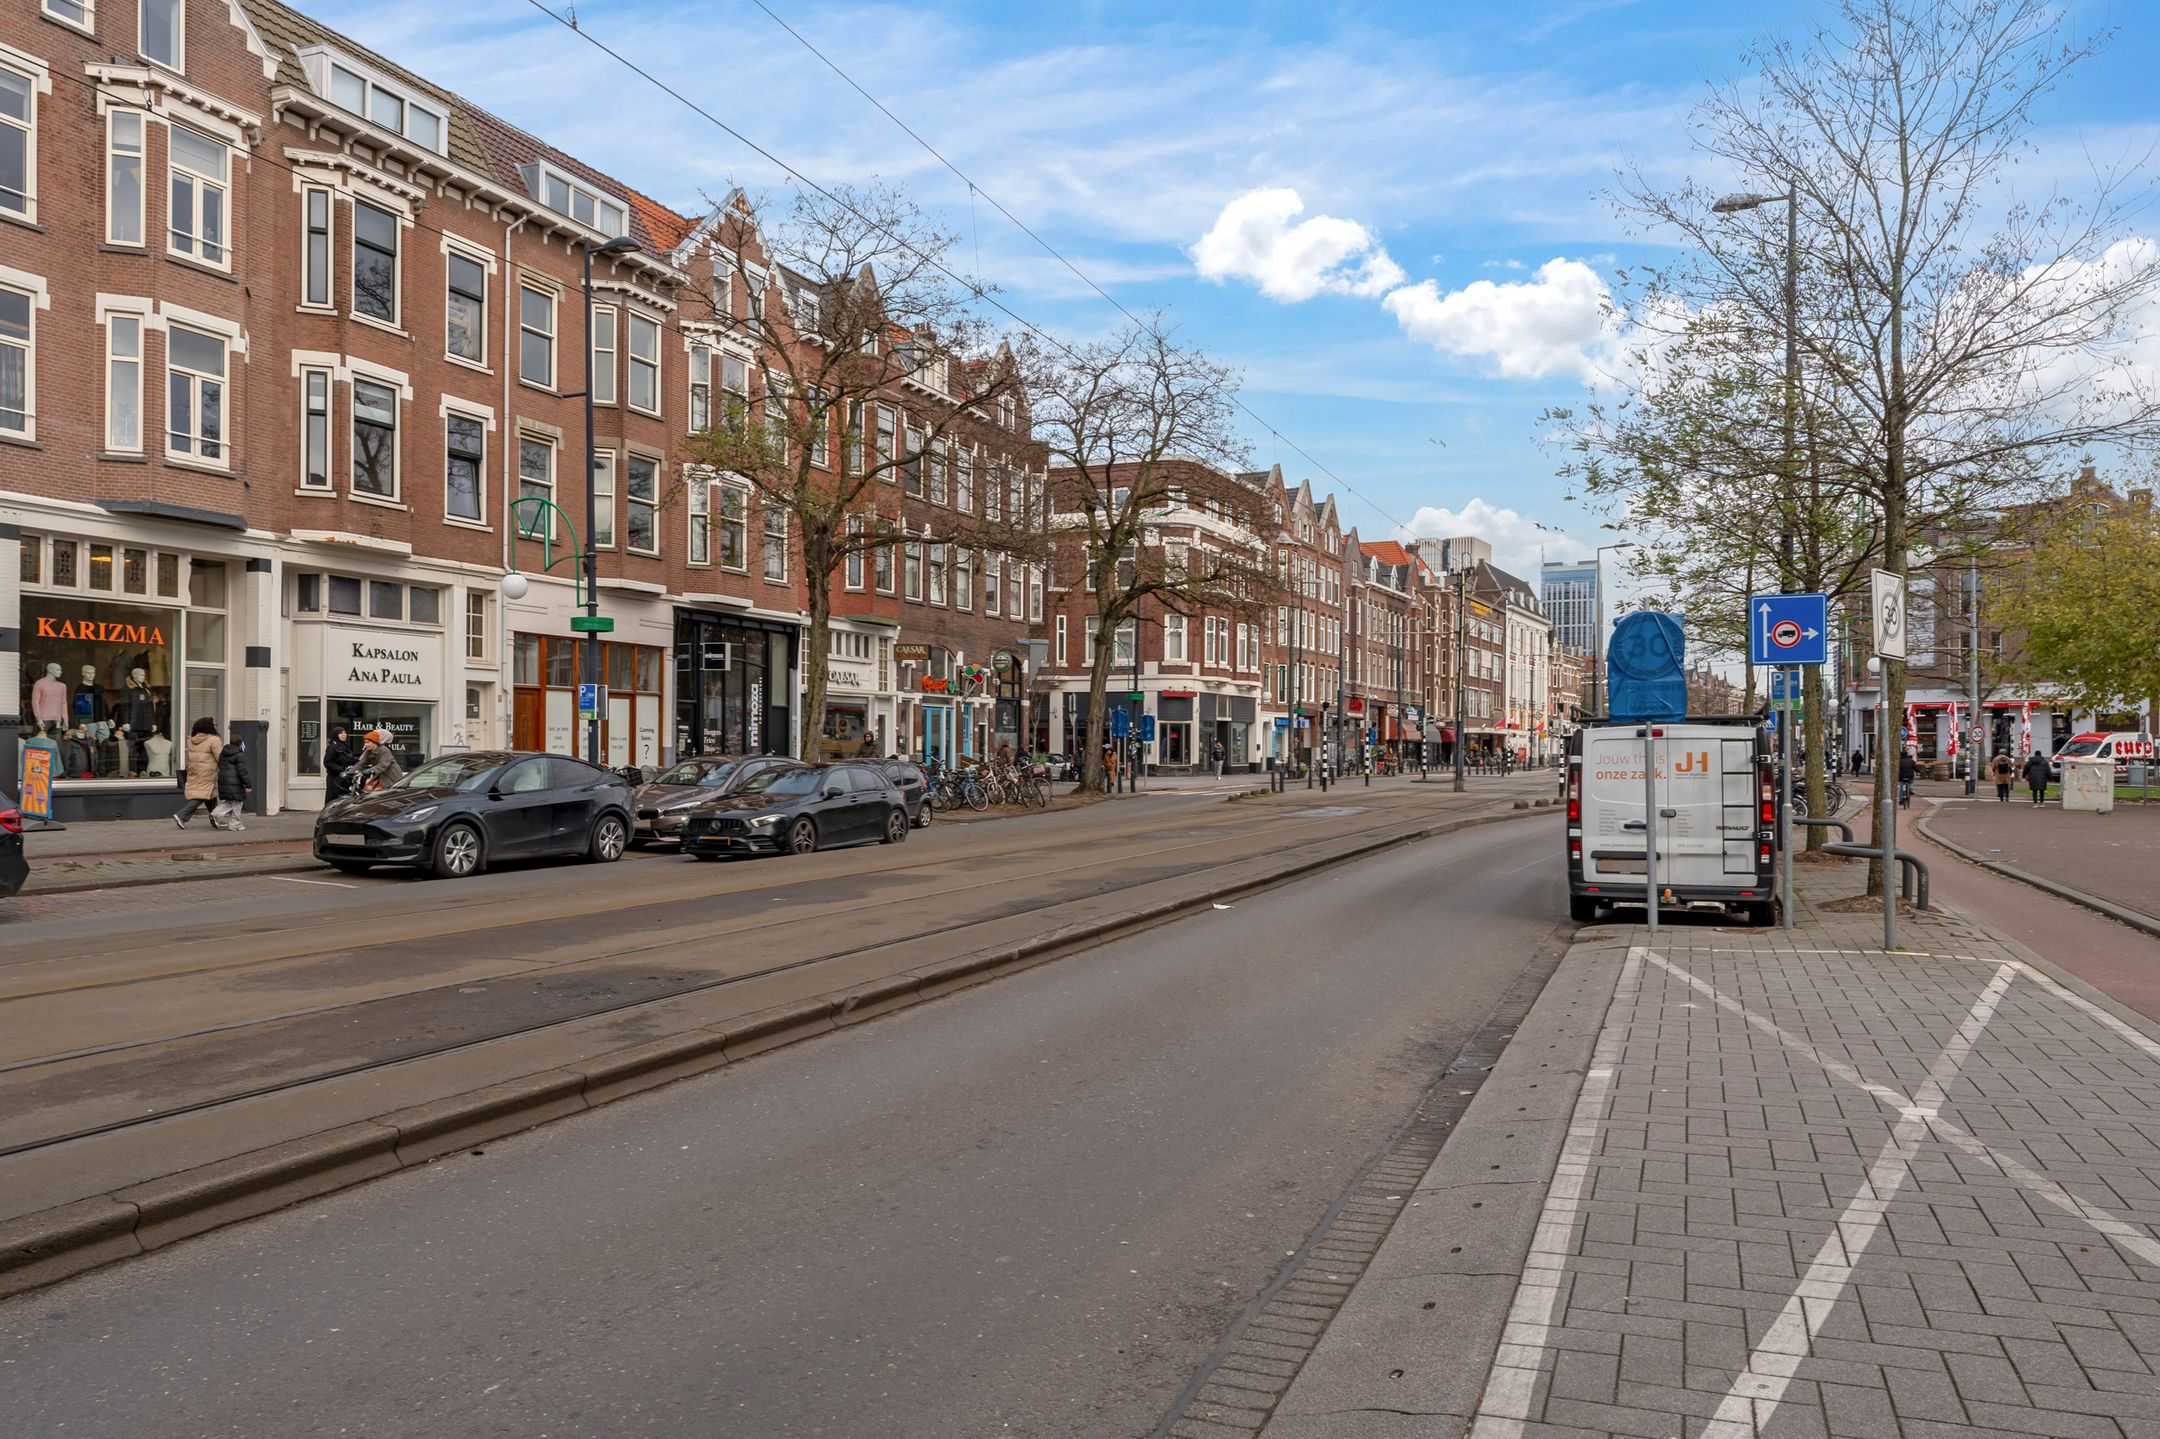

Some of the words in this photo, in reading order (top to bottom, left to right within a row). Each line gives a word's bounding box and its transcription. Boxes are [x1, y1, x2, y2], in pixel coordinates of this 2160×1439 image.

[36, 617, 165, 645] KARIZMA
[352, 642, 419, 662] KAPSALON
[896, 645, 927, 655] CAESAR
[348, 667, 378, 683] ANA
[381, 669, 422, 685] PAULA
[749, 683, 759, 747] mimoza
[353, 721, 374, 731] HAIR
[375, 721, 383, 731] &
[385, 722, 414, 732] BEAUTY
[1973, 730, 1982, 738] 30
[1596, 752, 1633, 765] Jouw
[1634, 752, 1665, 765] this
[1675, 752, 1708, 773] JH
[1596, 770, 1628, 780] onze
[1631, 768, 1667, 780] zak.
